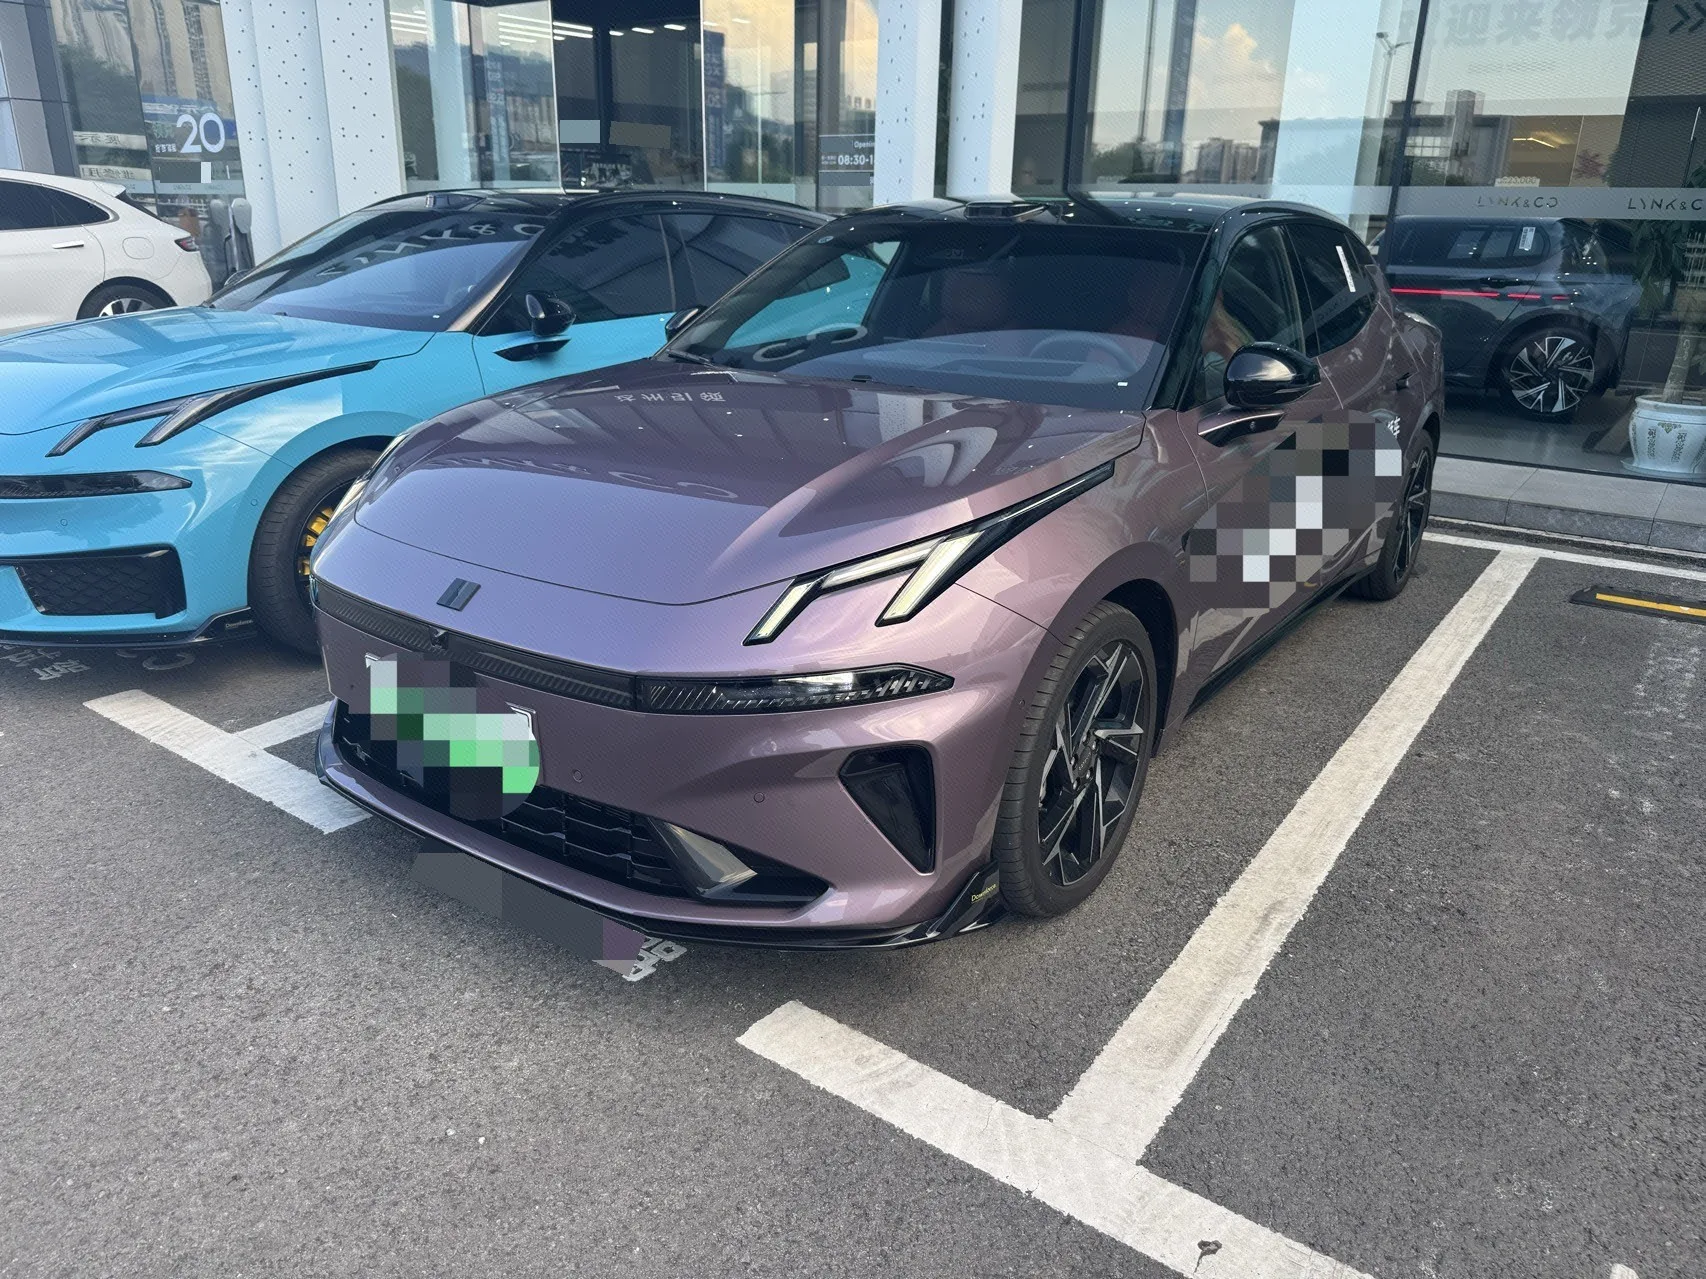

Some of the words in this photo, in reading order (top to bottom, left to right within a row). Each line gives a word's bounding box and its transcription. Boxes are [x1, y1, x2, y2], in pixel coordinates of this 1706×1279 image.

[176, 112, 225, 153] 20
[837, 154, 874, 166] 08:30-1
[1627, 197, 1705, 211] LYNK&C
